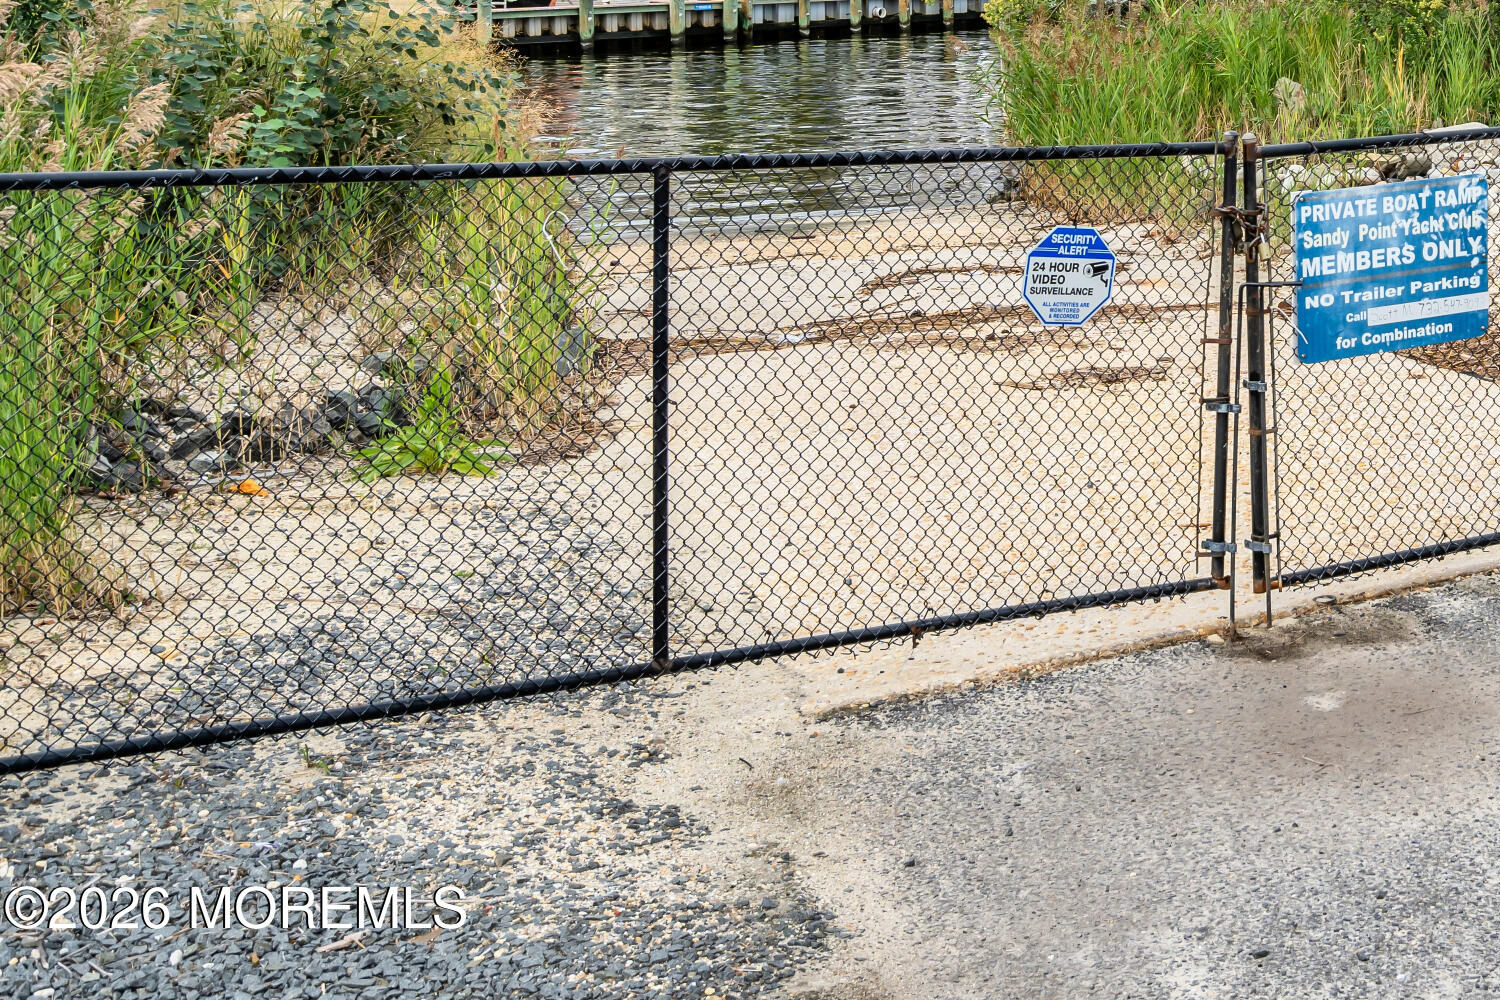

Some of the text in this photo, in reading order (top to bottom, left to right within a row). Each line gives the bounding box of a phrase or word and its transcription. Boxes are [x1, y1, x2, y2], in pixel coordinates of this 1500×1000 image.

[1301, 186, 1482, 223] PRIVATE BOAT RAMP
[1303, 210, 1480, 248] Sandy Point Yacht Club
[1051, 233, 1097, 245] SECURITY
[1058, 246, 1088, 255] ALERT
[1302, 235, 1482, 278] MEMBERS ONLY
[1033, 262, 1079, 273] 24 HOUR
[1032, 274, 1065, 284] VIDEO
[1030, 287, 1093, 295] SURVEILLANCE
[1305, 274, 1480, 309] NO Trailer Parking
[1346, 310, 1366, 323] Call
[1336, 321, 1453, 350] for Combination
